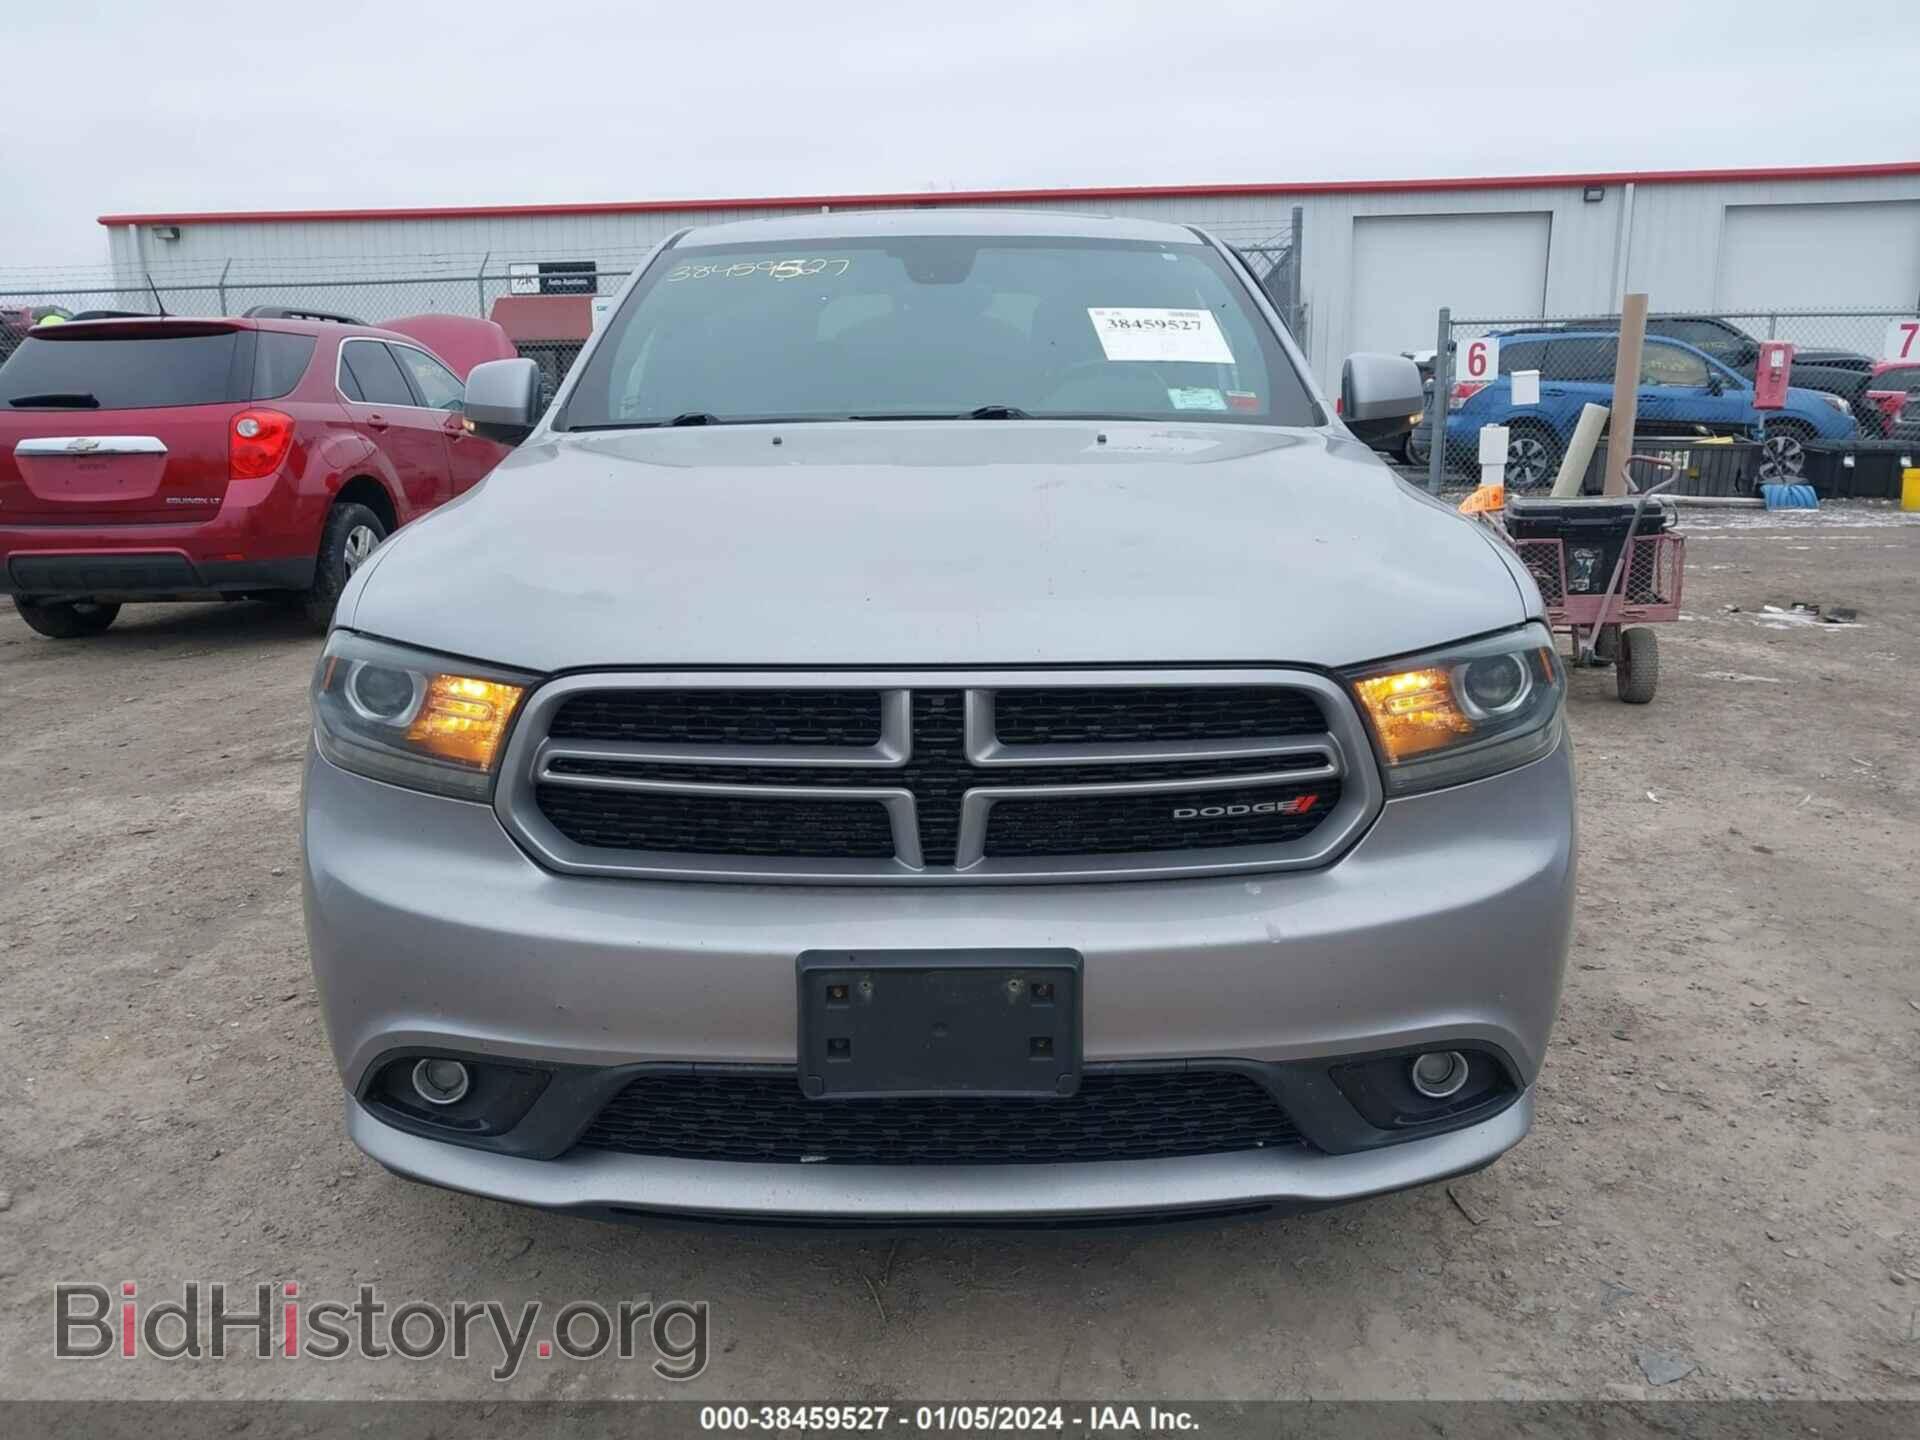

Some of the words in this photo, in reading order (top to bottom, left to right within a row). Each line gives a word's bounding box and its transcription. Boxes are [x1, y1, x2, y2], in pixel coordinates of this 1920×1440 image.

[1106, 319, 1201, 330] 38459527
[1900, 323, 1919, 358] 7
[1468, 342, 1487, 377] 6
[1173, 800, 1299, 818] DODGE
